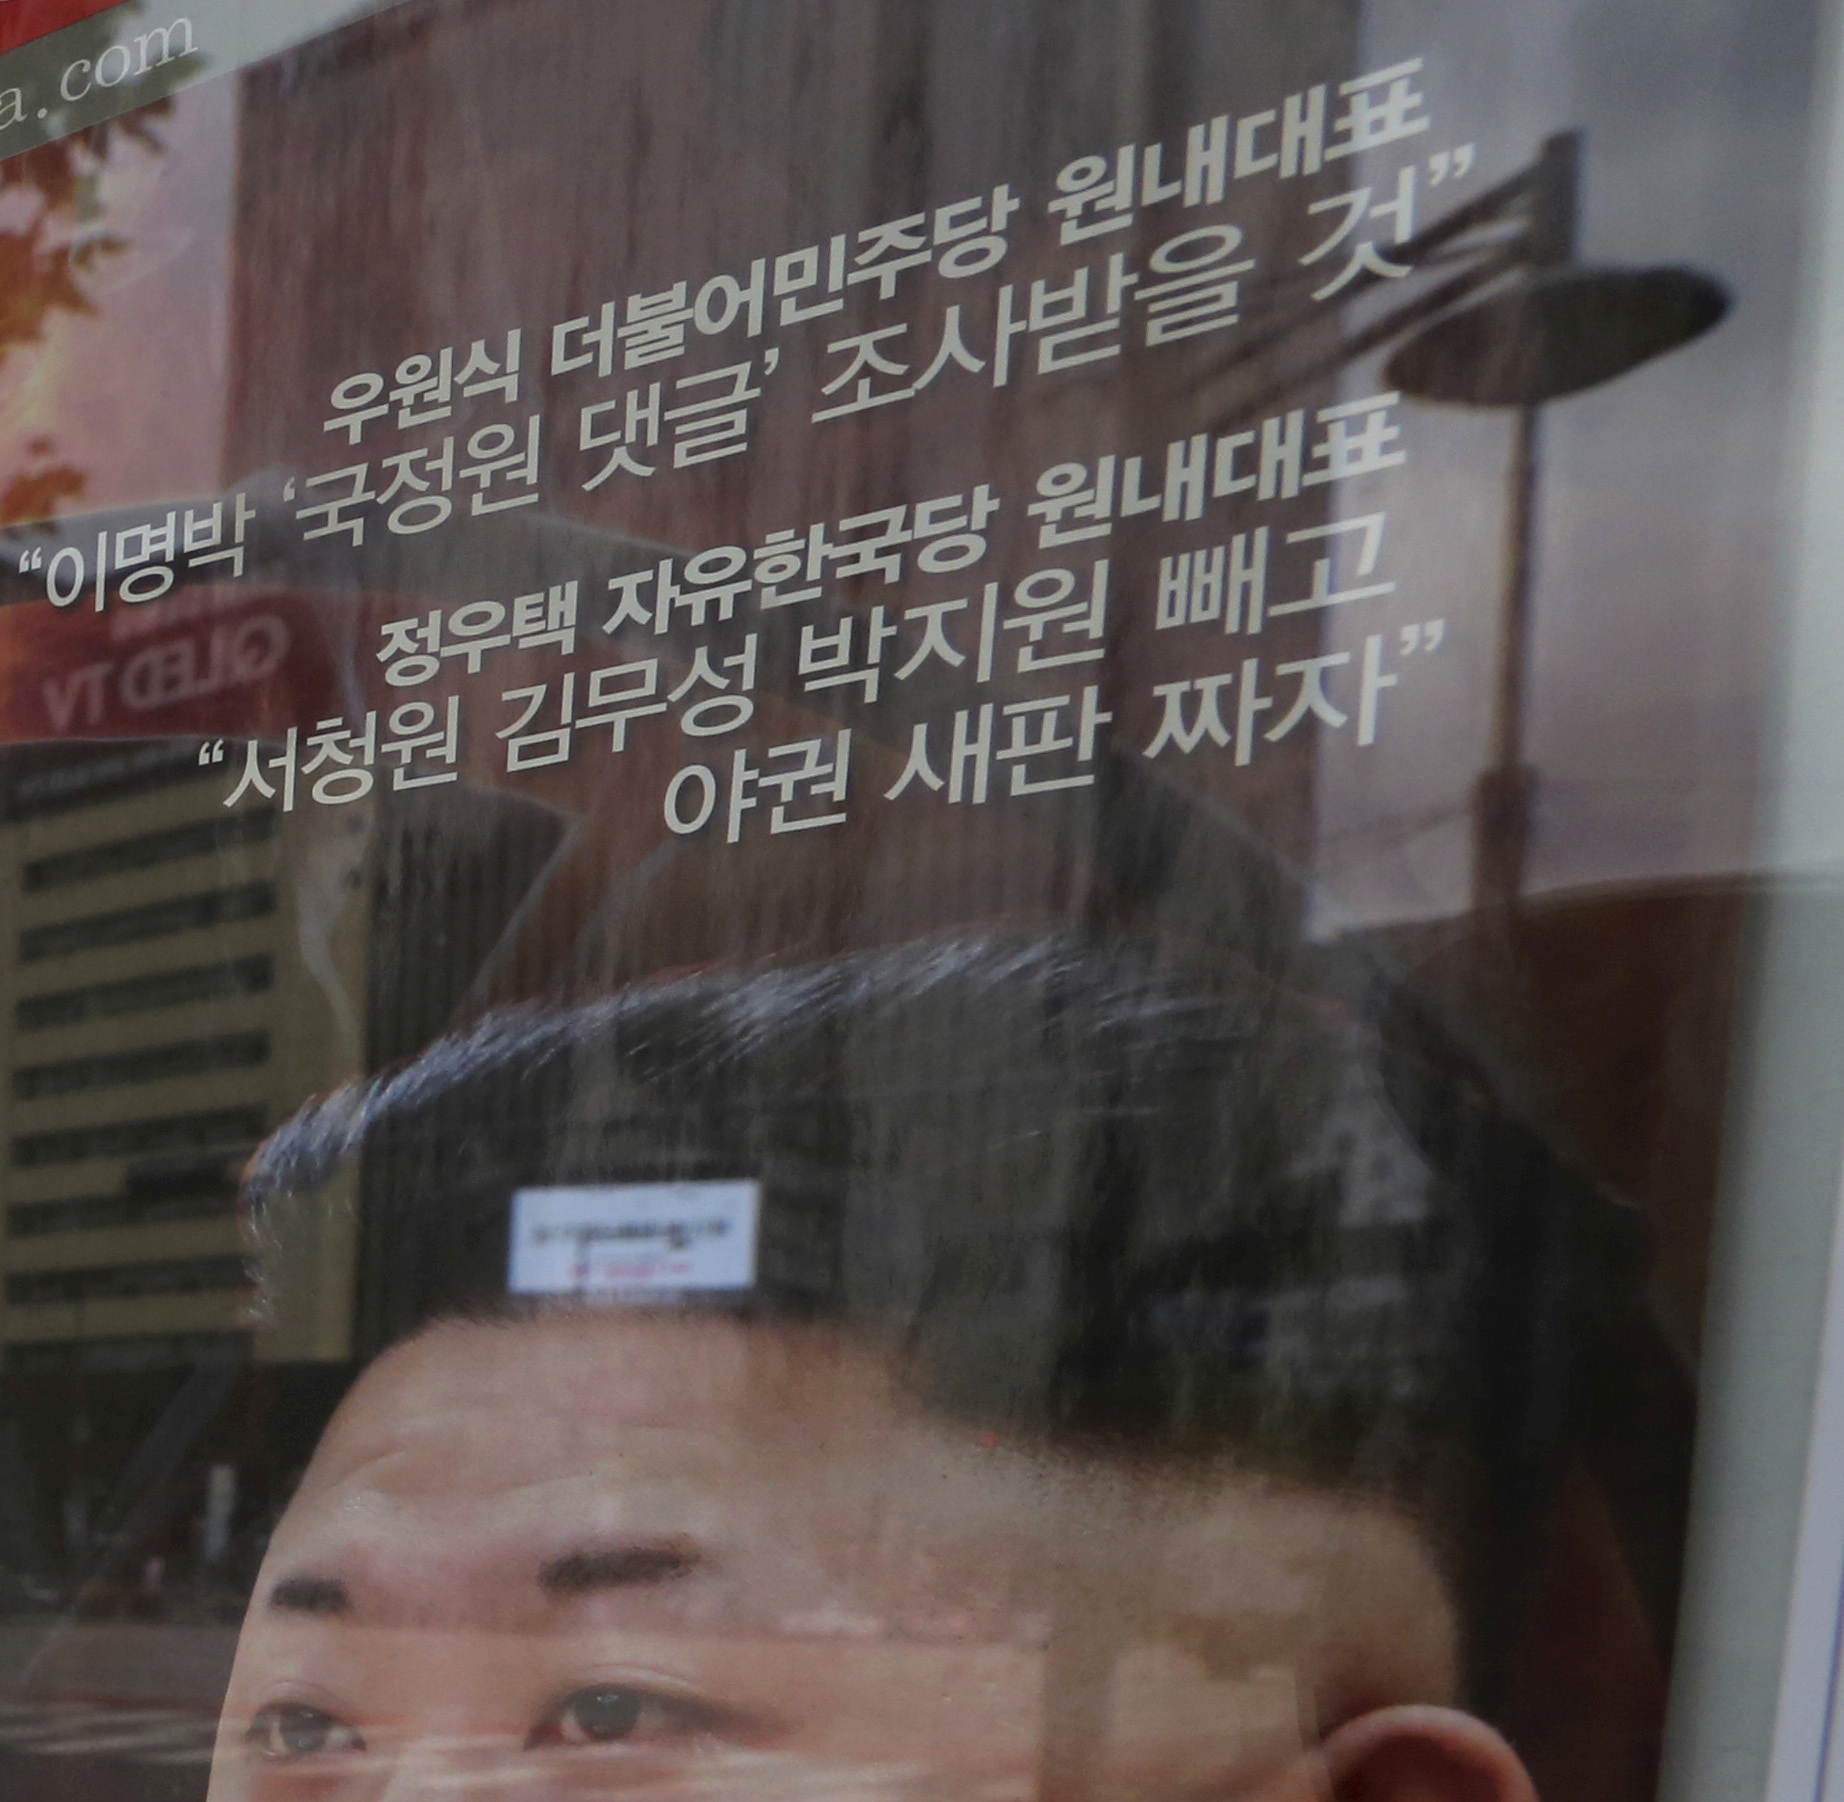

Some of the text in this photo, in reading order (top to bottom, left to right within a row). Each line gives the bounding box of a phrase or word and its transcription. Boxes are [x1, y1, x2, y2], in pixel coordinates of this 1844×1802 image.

[18, 493, 256, 611] “이명박
[283, 414, 540, 547] ‘국정원
[579, 348, 777, 492] 댓글’
[811, 223, 1255, 424] 조사받을
[1299, 143, 1475, 302] 것”
[323, 56, 1432, 445] 우원식 더불어민주당 원내대표
[198, 694, 460, 813] “서청원
[495, 633, 758, 773] 김무성
[797, 559, 1108, 705] 박지원
[1156, 512, 1396, 635] 빼고
[376, 391, 1407, 688] 정우택 자유한국당 원내대표
[662, 619, 1445, 844] 야권 새판 짜자”
